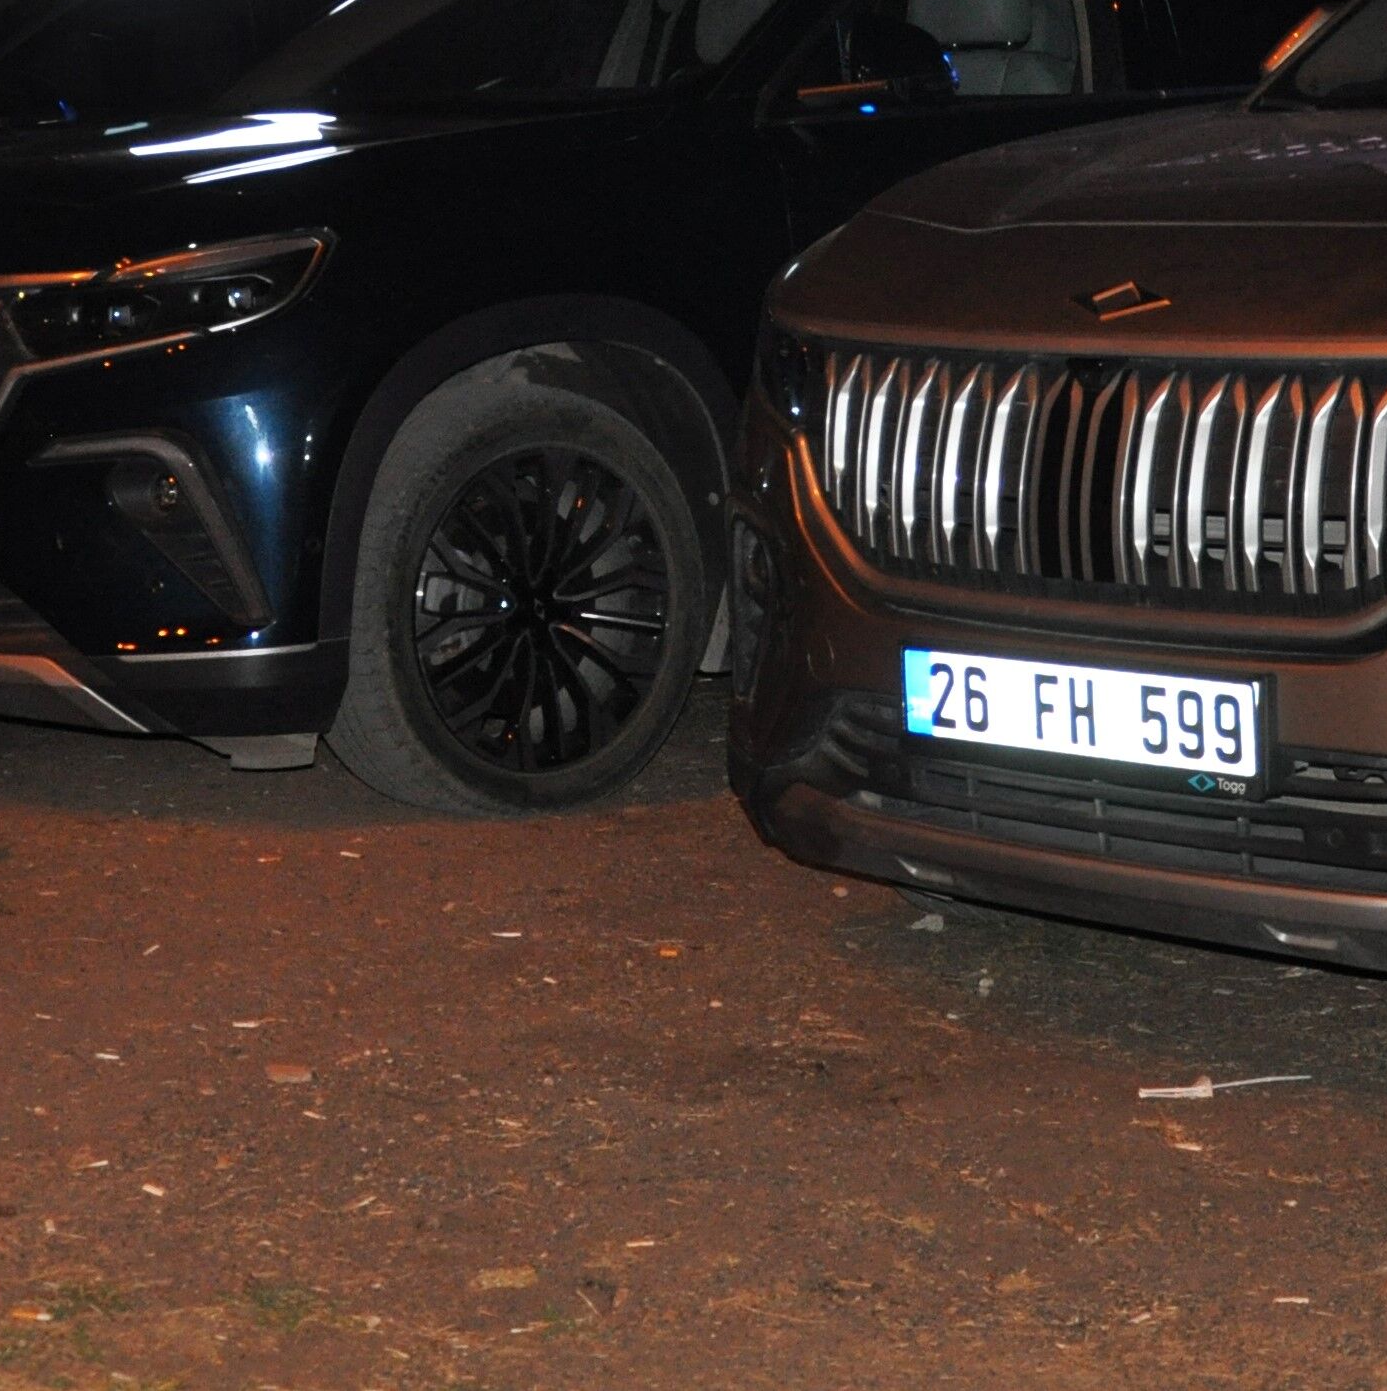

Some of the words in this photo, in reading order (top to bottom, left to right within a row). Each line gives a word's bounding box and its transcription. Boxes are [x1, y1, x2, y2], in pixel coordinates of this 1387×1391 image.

[929, 662, 989, 733] 26
[1033, 673, 1097, 747] FH
[1140, 685, 1244, 765] 599
[1216, 777, 1246, 795] Togg
